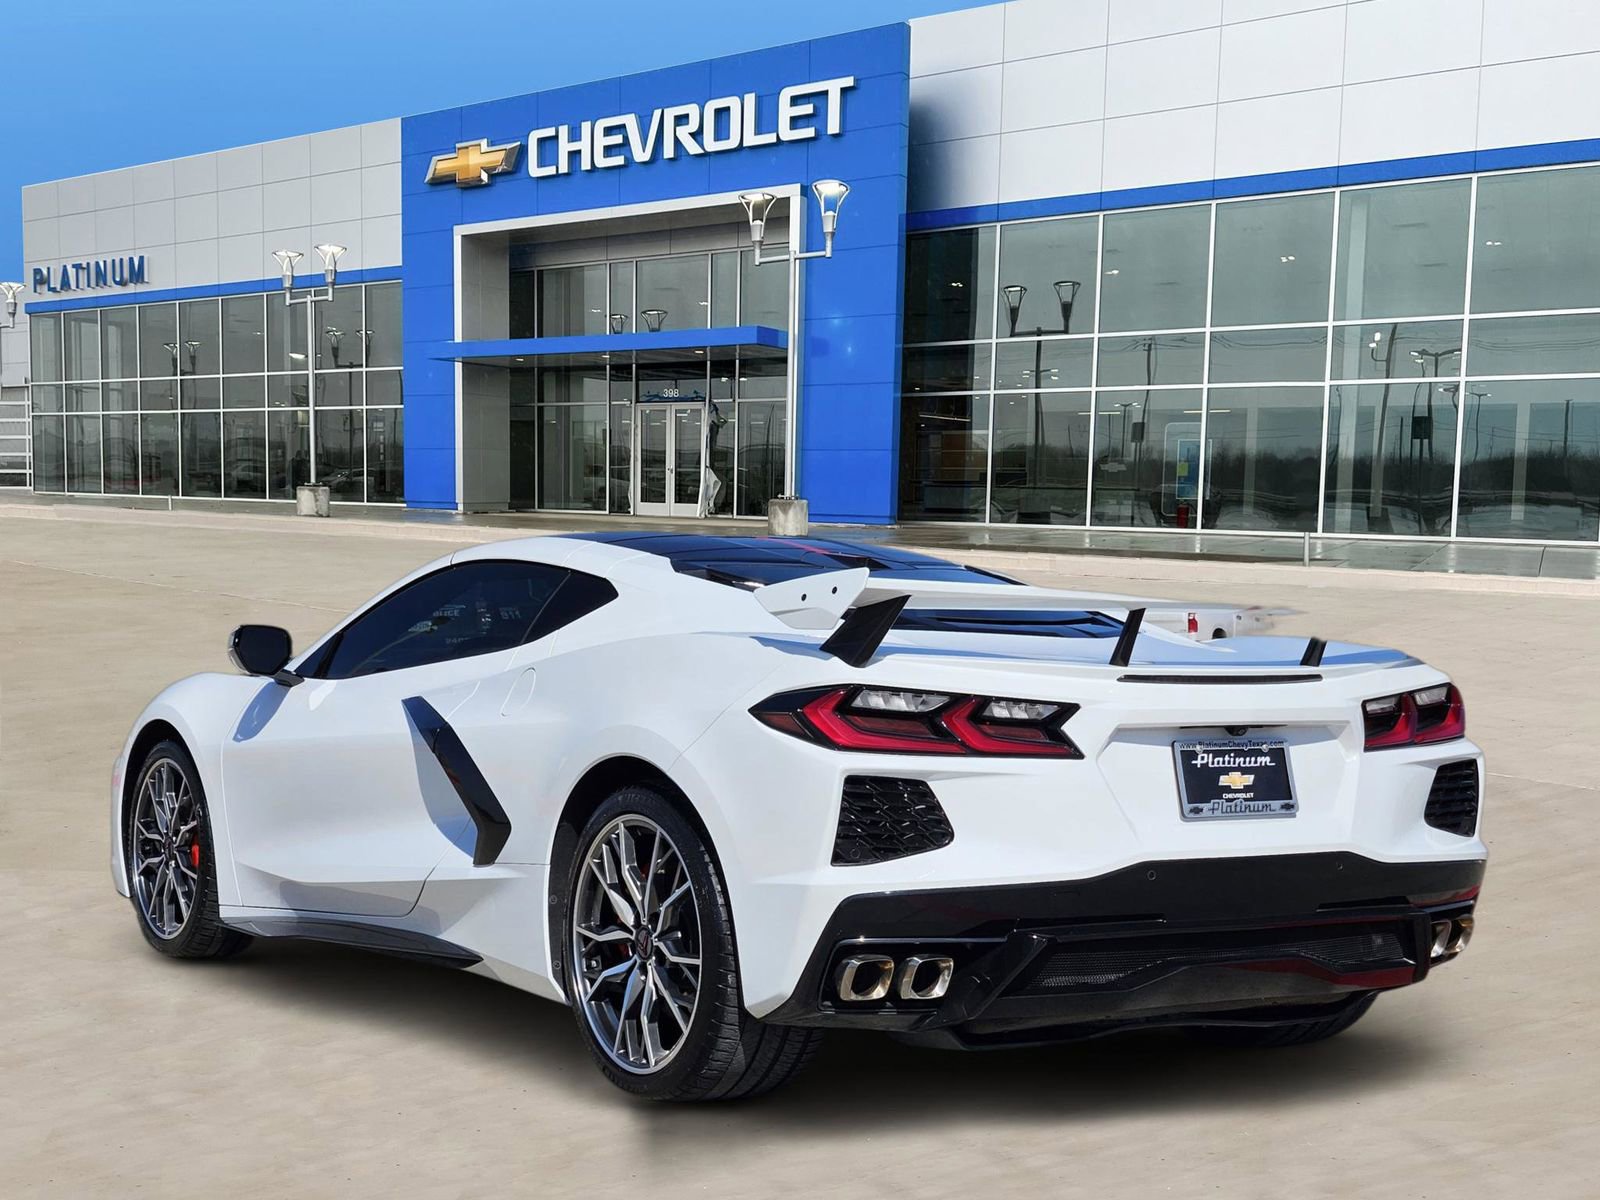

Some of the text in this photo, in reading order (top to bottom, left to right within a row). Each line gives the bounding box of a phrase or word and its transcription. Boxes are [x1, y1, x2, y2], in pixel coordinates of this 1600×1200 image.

[528, 76, 855, 178] CHEVROLET
[33, 255, 146, 294] PLATINUM
[663, 388, 679, 398] 398
[1179, 740, 1284, 750] wwwPlatinumChevyTexascom
[1192, 753, 1276, 768] Platinum
[1208, 800, 1276, 814] Platinum
